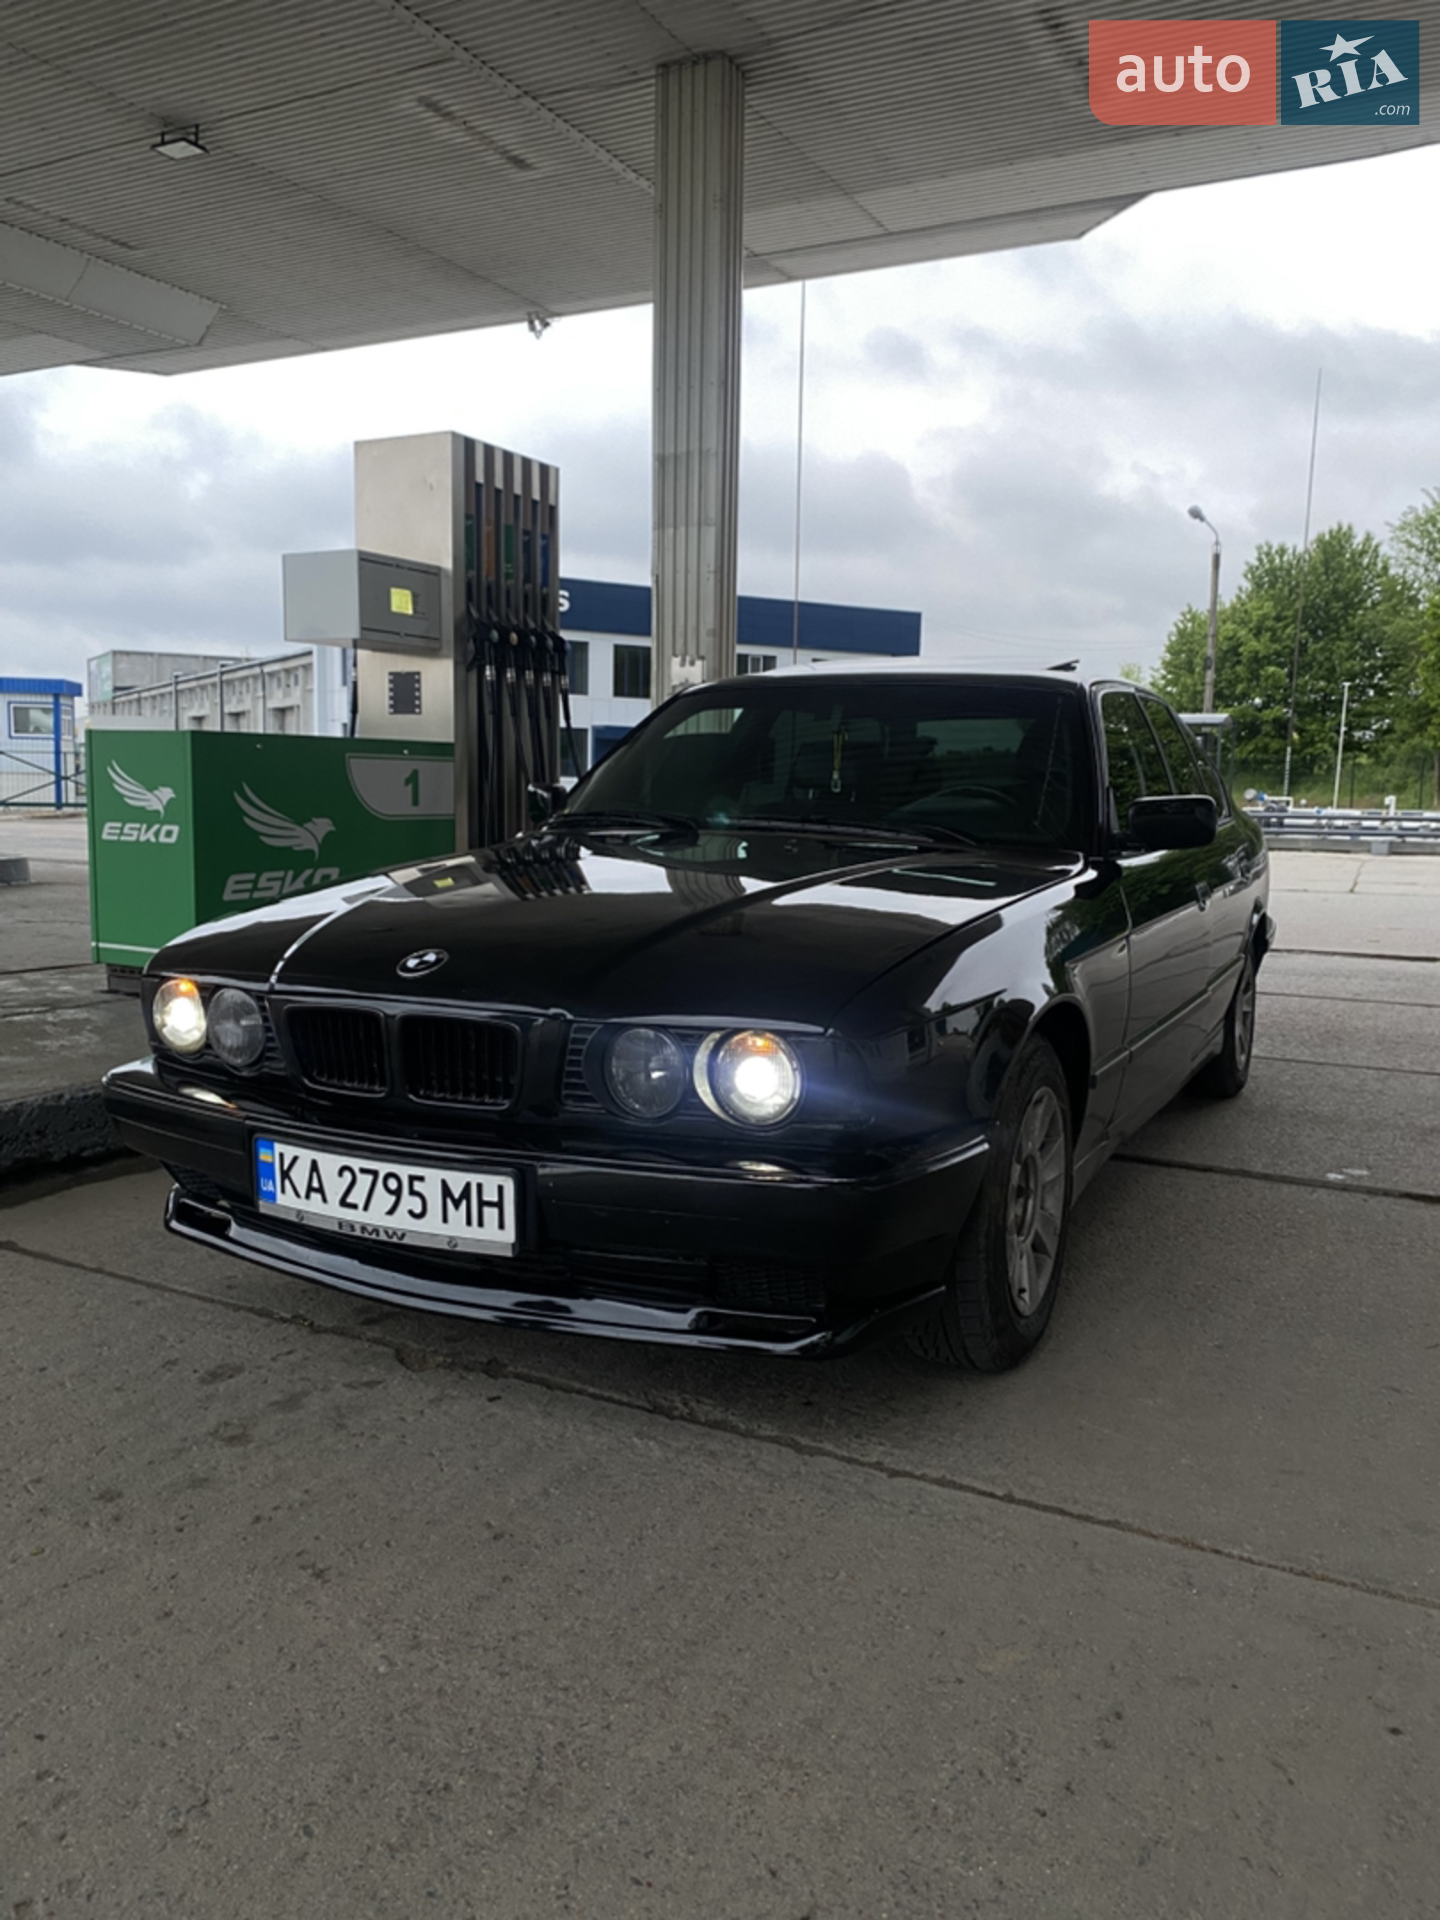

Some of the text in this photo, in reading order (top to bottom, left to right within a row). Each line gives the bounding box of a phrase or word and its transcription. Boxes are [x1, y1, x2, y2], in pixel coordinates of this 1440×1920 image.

[403, 768, 420, 807] 1
[101, 821, 180, 844] ESKO
[260, 1178, 275, 1193] UA
[278, 1151, 506, 1231] KA 2795 MH
[337, 1220, 407, 1242] BMW
